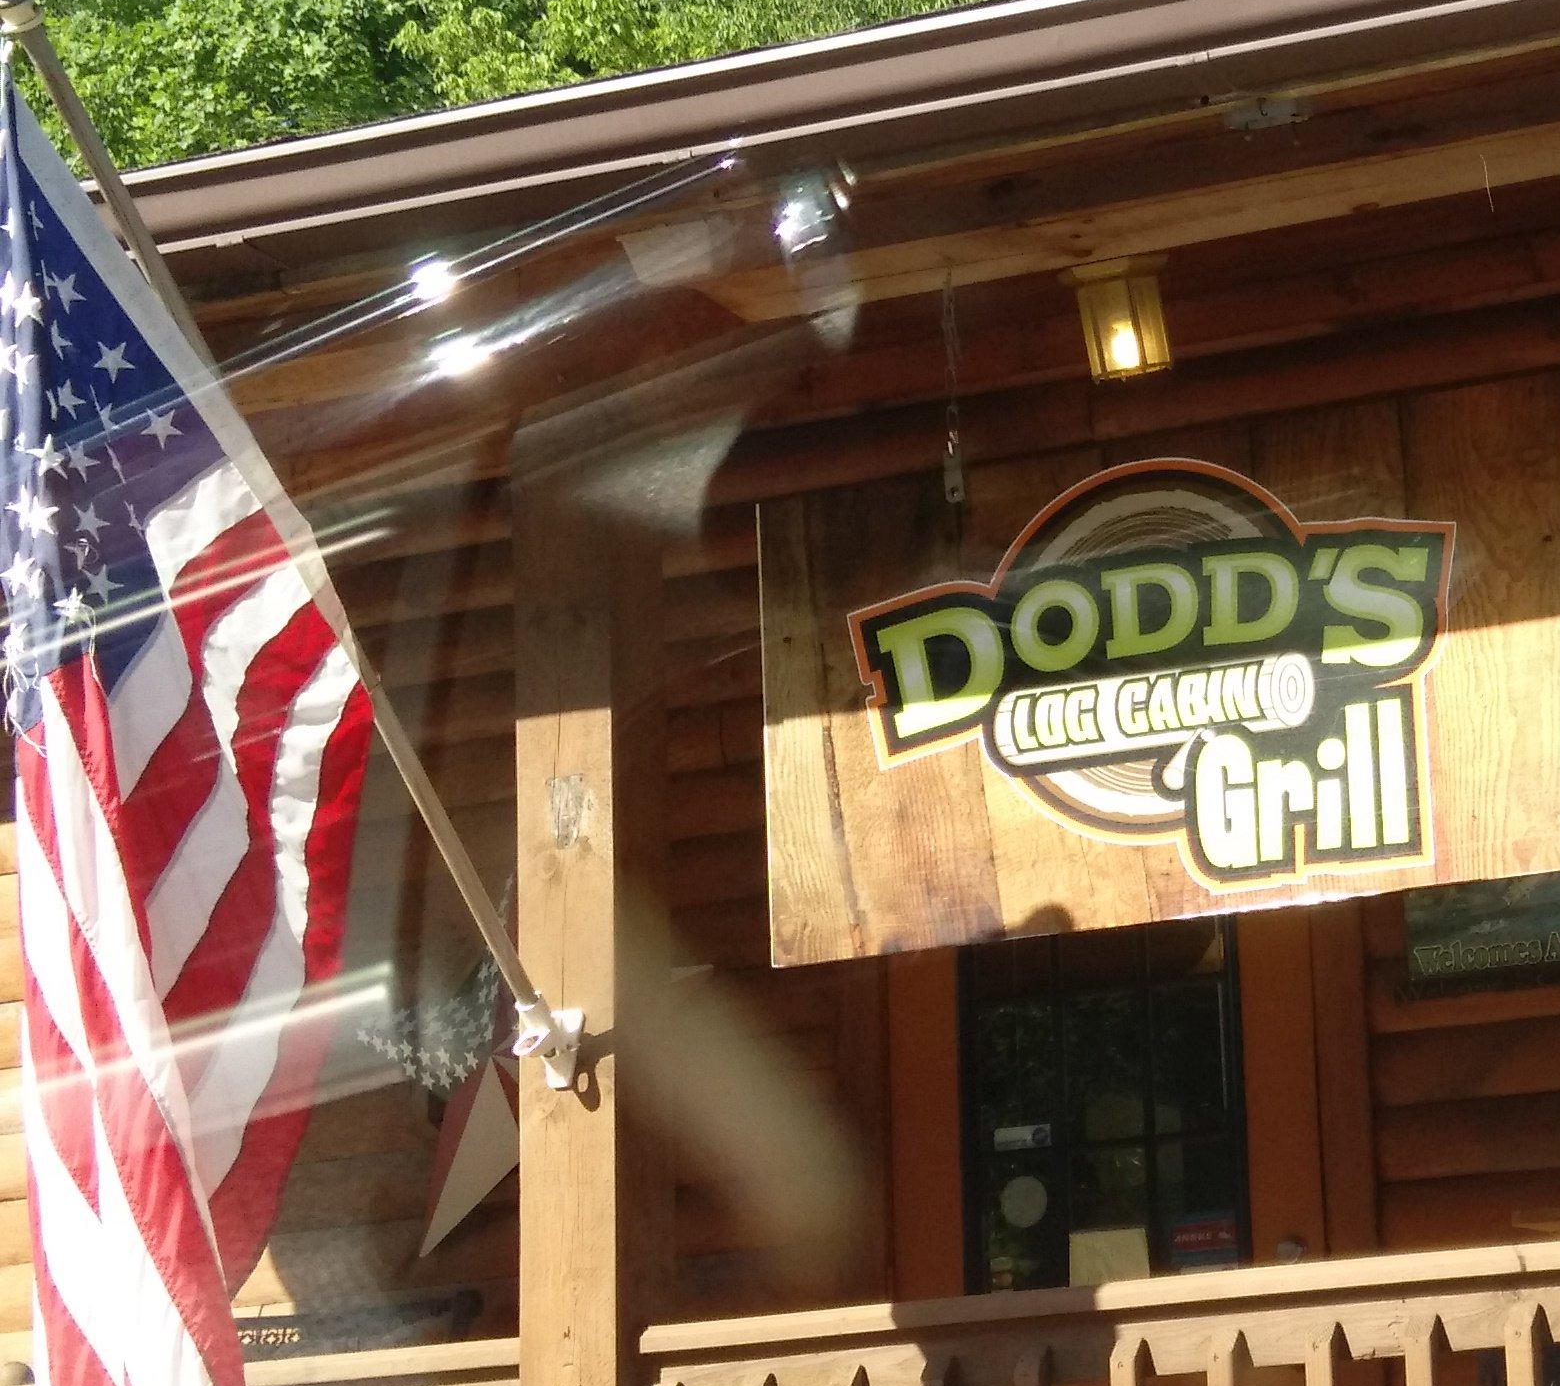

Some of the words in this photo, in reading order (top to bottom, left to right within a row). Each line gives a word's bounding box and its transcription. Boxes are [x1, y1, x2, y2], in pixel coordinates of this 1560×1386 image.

[876, 545, 1429, 740] DODD'S
[1012, 685, 1103, 753] LOG
[1115, 661, 1264, 738] CABIN
[1196, 698, 1411, 869] Grill
[1413, 939, 1542, 976] Welcomes
